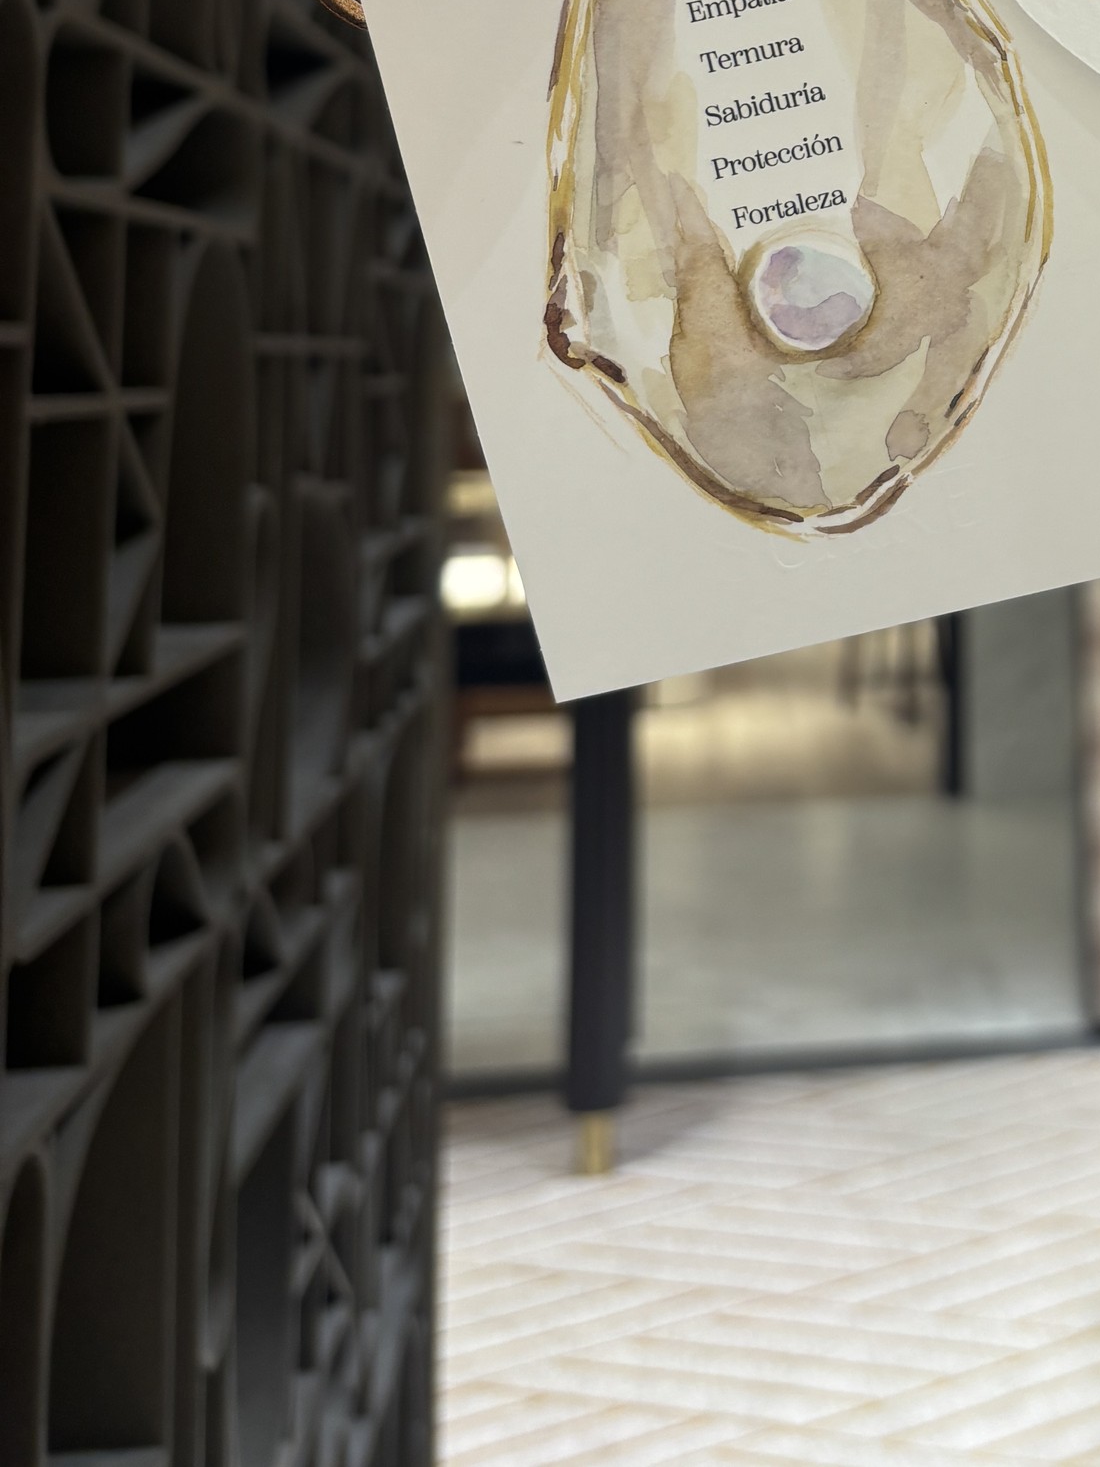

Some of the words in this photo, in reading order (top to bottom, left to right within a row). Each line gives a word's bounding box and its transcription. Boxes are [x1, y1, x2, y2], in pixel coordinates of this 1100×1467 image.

[699, 37, 805, 73] Ternura
[704, 82, 826, 127] Sabiduría
[711, 133, 843, 180] Protección
[731, 189, 847, 229] Fortaleza
